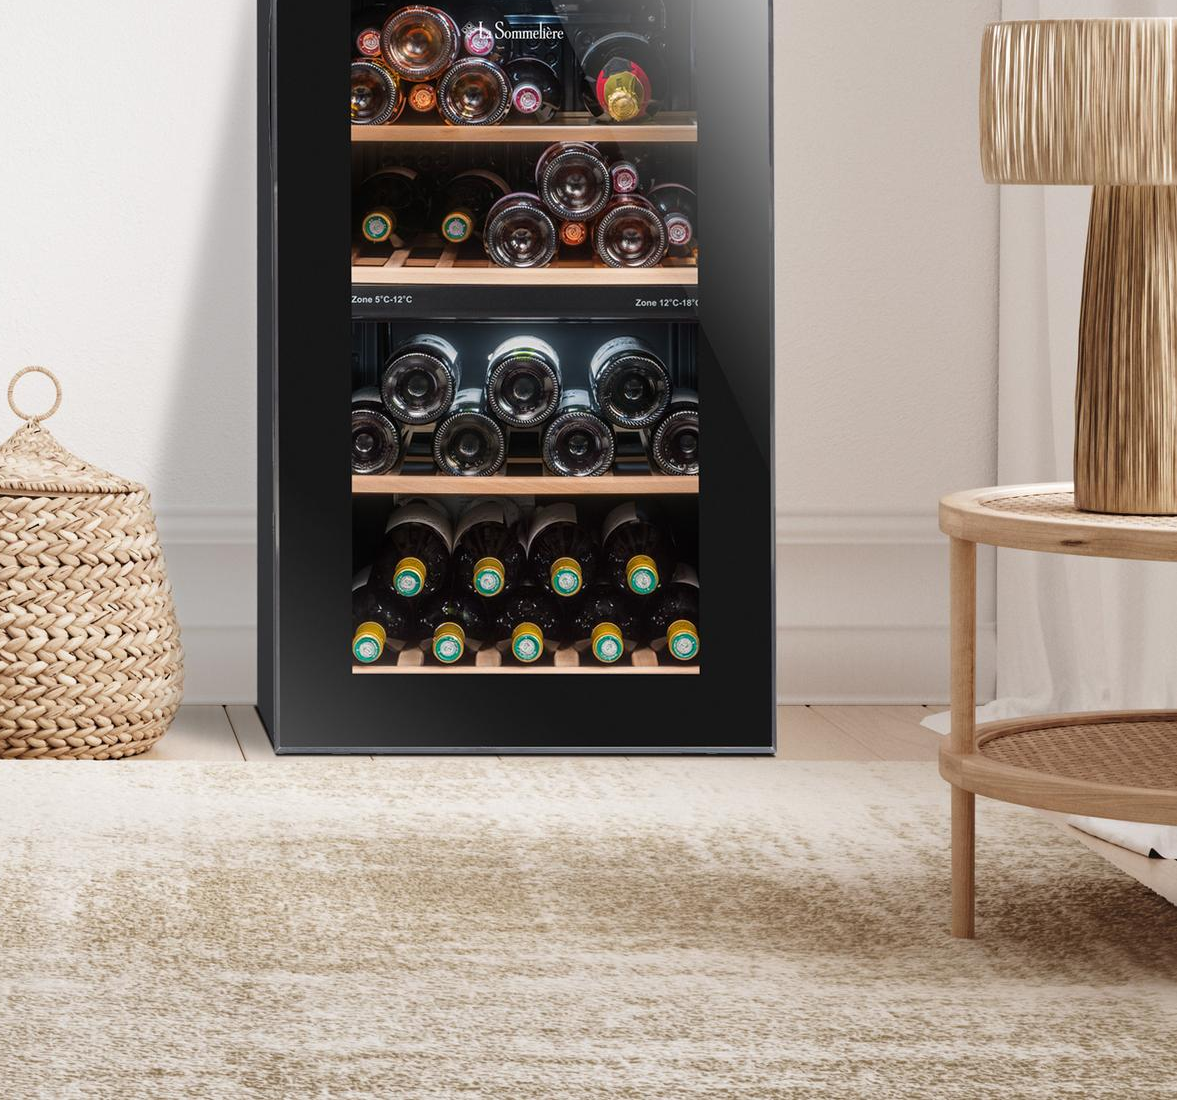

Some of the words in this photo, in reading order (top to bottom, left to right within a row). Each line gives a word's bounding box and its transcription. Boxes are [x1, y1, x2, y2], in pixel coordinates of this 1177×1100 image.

[478, 21, 492, 39] La
[495, 20, 564, 40] Sommelière
[351, 295, 373, 303] Zone
[635, 298, 657, 307] Zone
